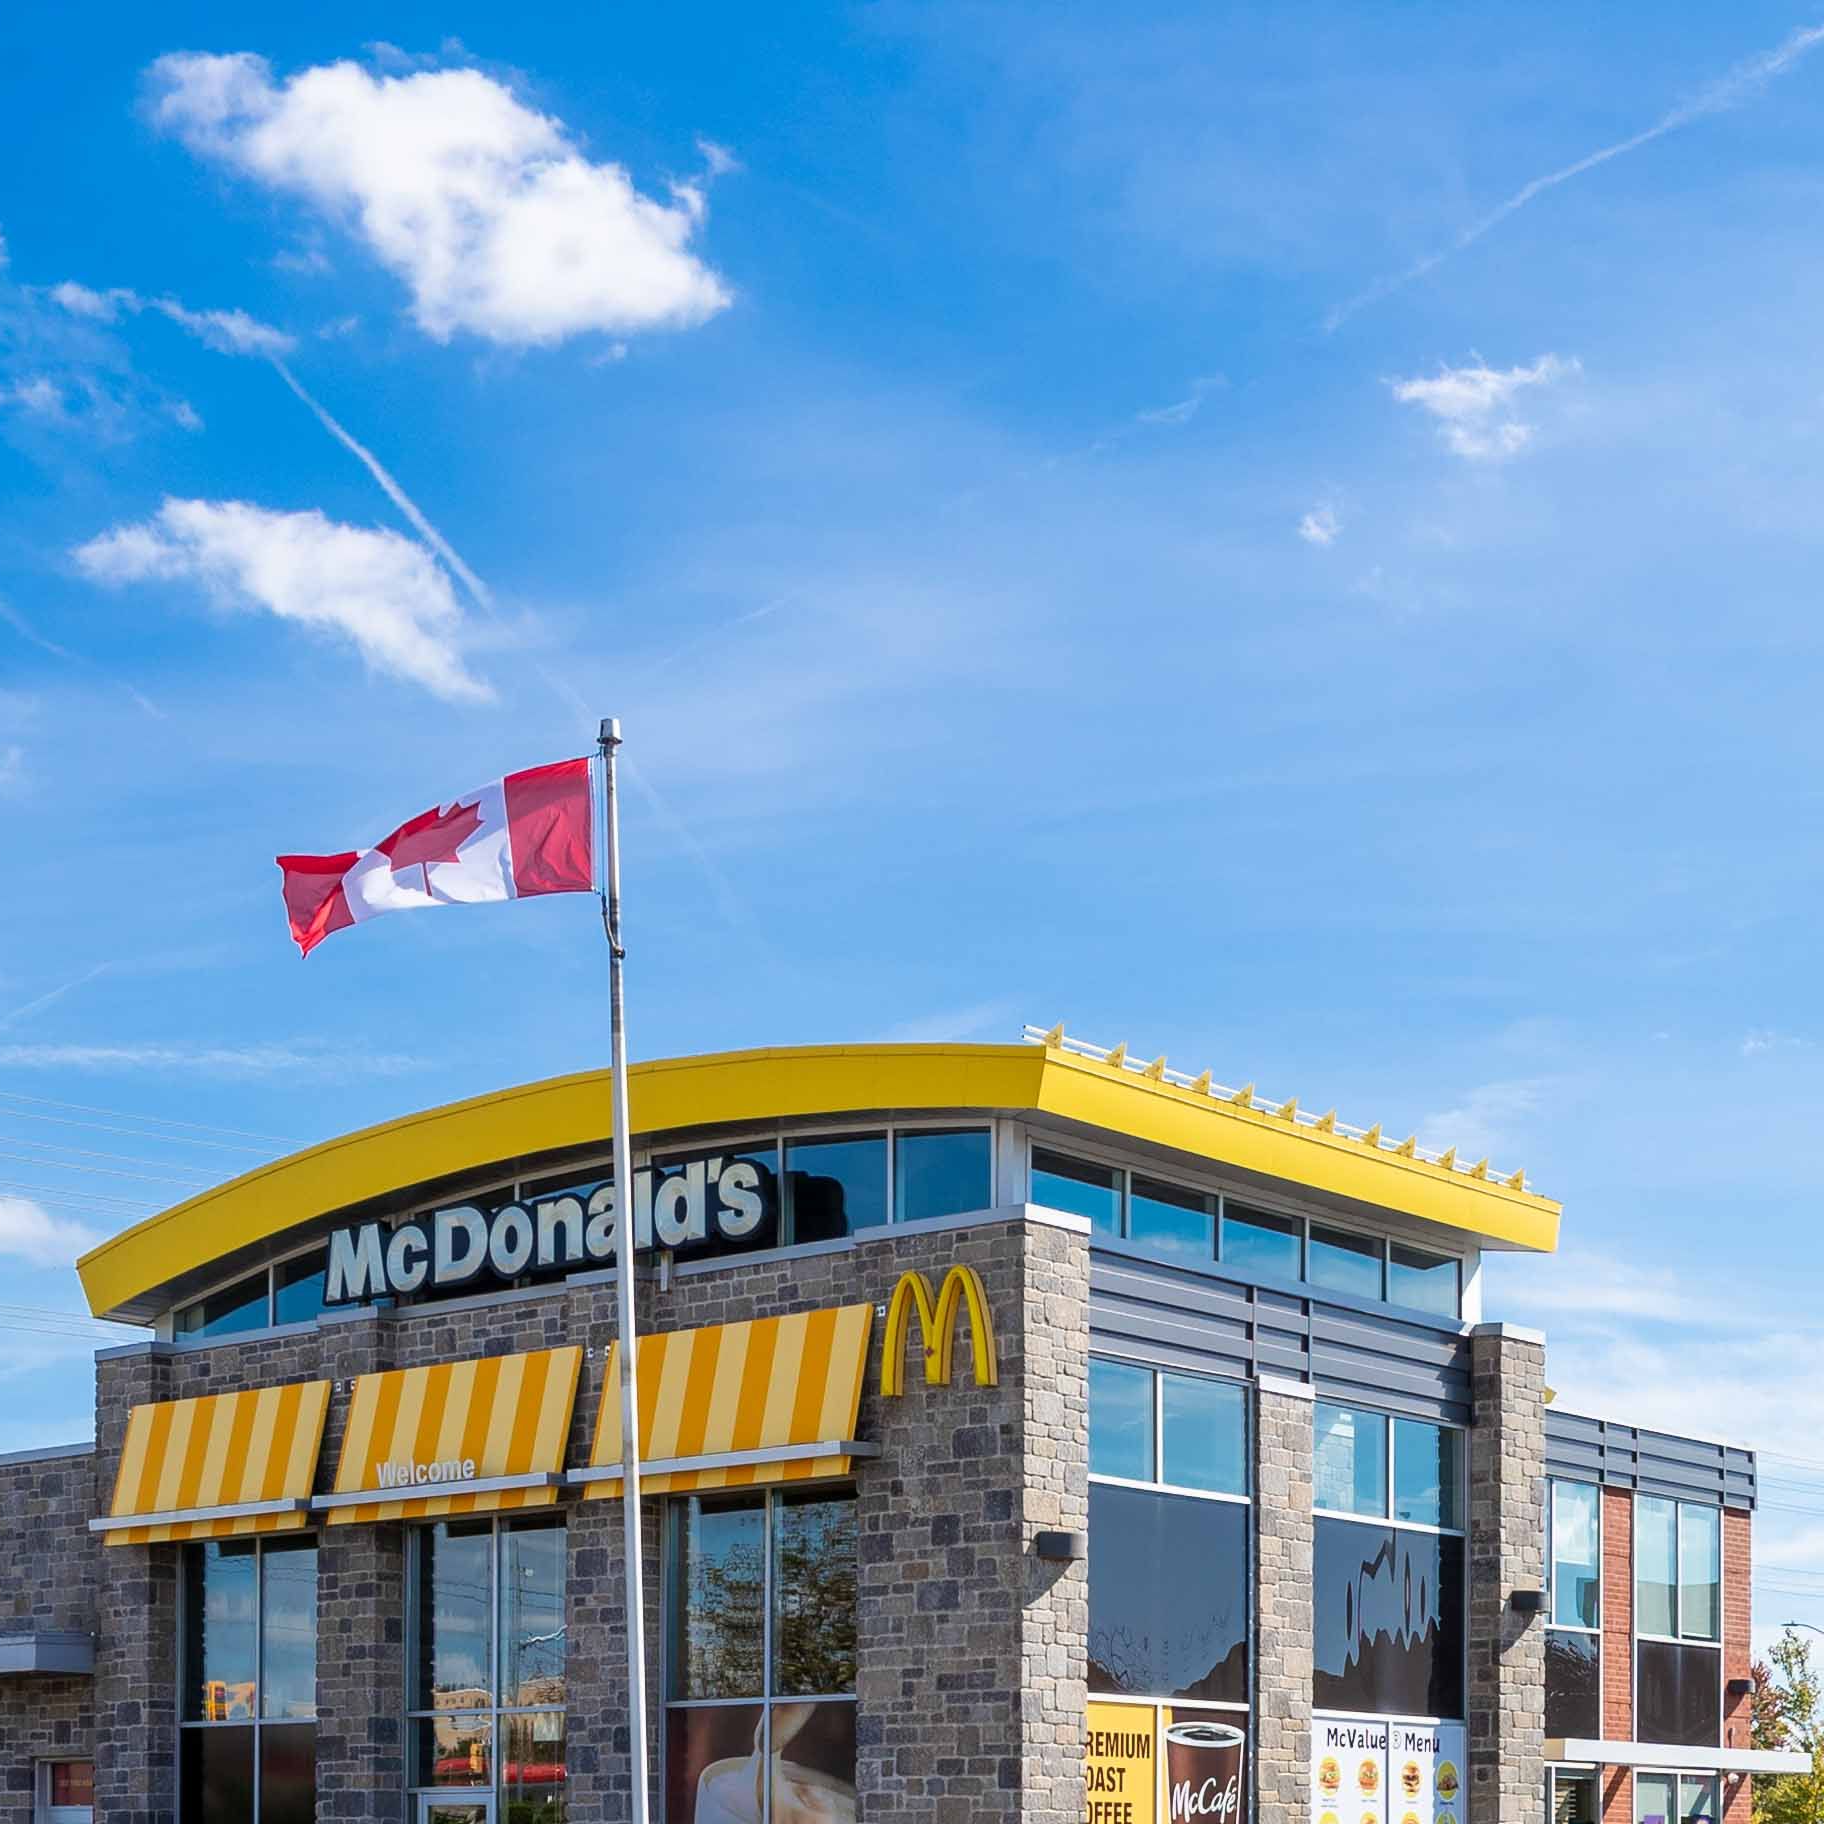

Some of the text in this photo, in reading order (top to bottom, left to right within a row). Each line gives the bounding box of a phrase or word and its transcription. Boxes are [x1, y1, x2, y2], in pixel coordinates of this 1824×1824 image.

[326, 1156, 764, 1302] McDonald's
[376, 1457, 476, 1489] Welcome
[1086, 1731, 1151, 1759] REMIUM
[1326, 1727, 1441, 1753] McValue Menu
[1086, 1766, 1126, 1793] OAST
[1172, 1775, 1238, 1824] McCafé
